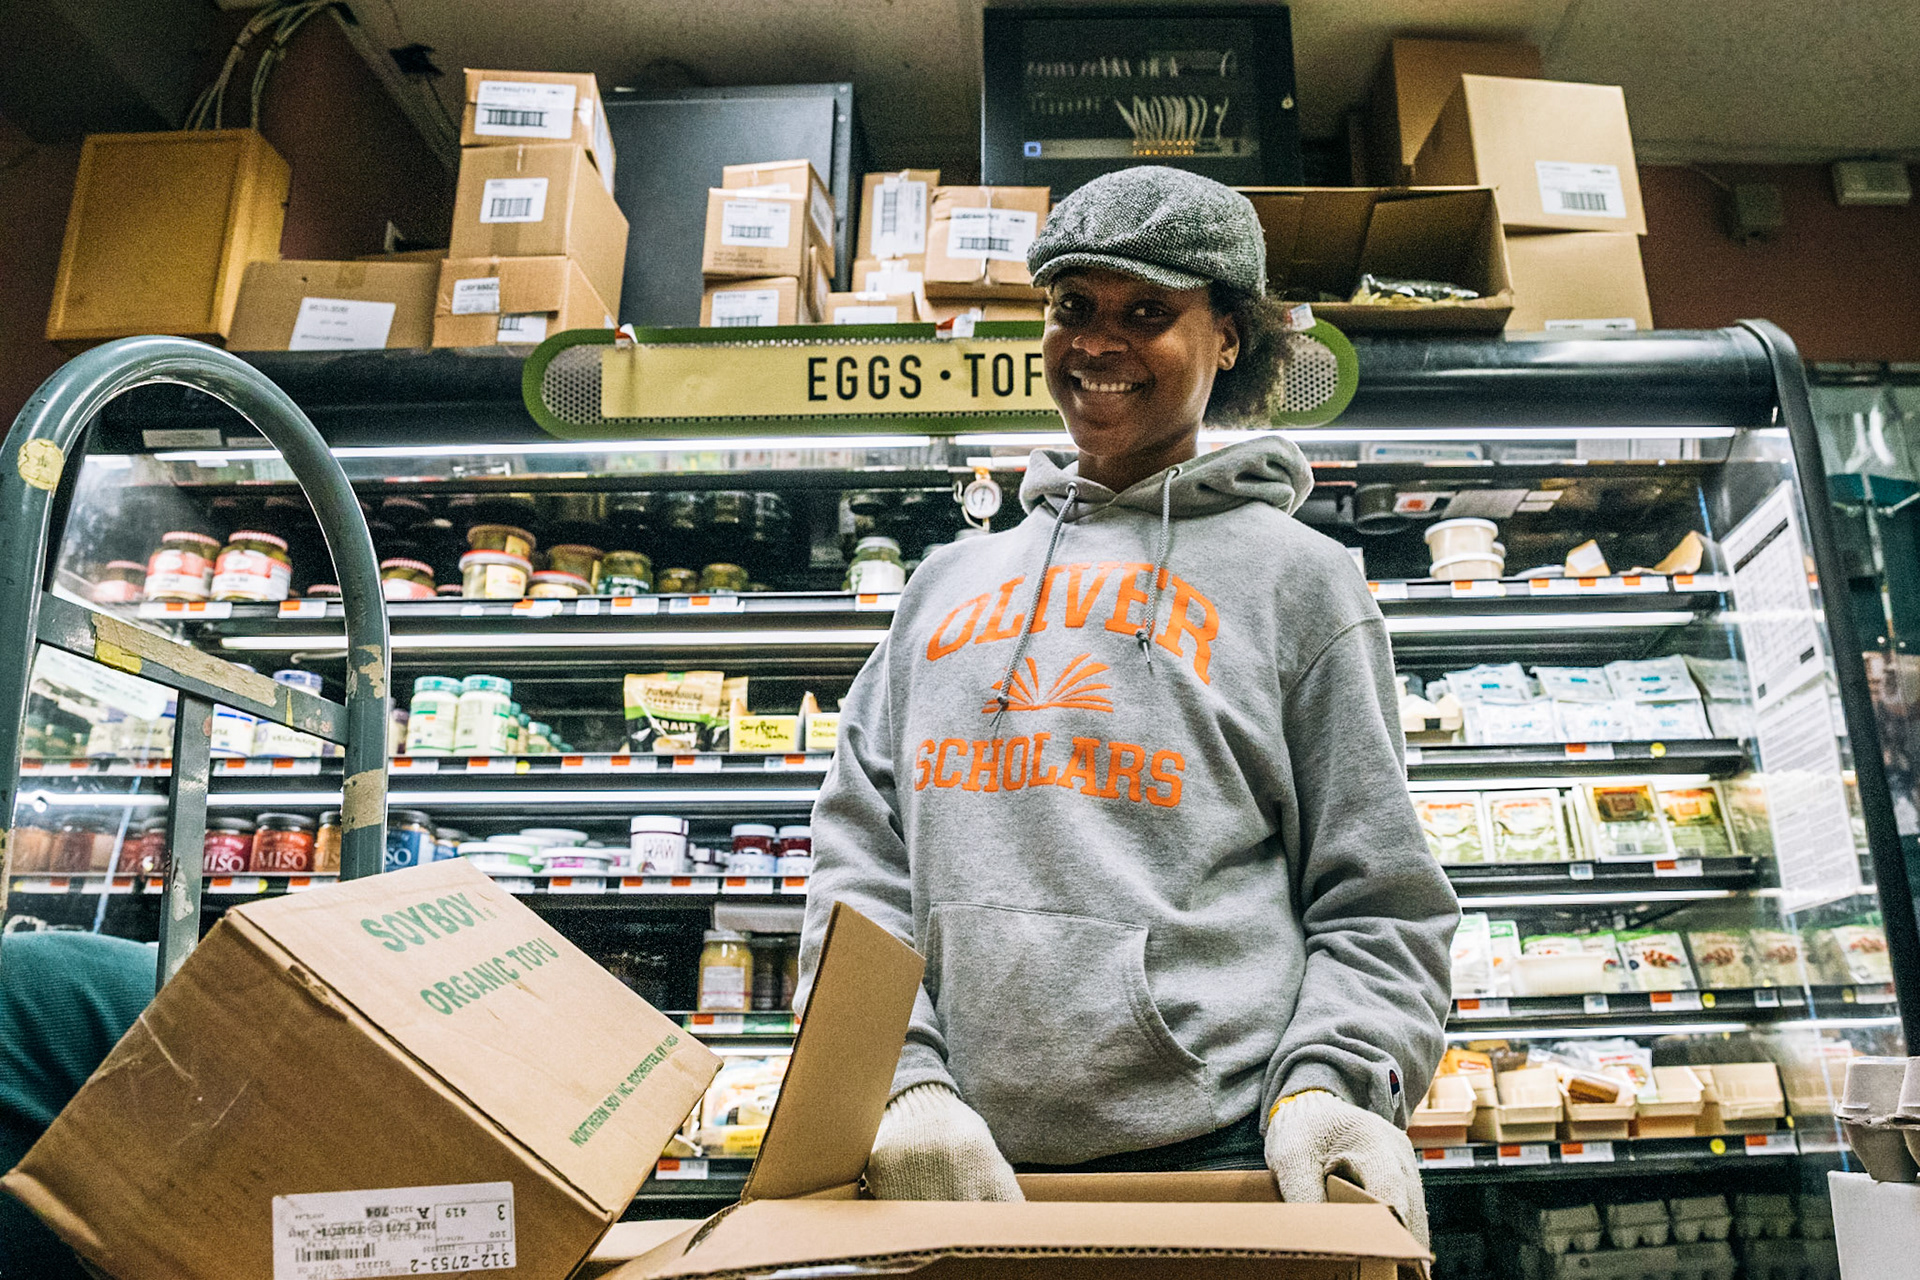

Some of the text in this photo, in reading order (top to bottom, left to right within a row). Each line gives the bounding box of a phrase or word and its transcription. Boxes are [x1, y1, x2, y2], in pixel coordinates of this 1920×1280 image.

[808, 352, 1043, 401] EGGS TOF
[926, 560, 1220, 685] OLIVER
[658, 718, 697, 732] RAUT
[914, 731, 1186, 808] SCHOLARS
[257, 850, 307, 872] MISO
[385, 847, 412, 866] SO
[360, 892, 484, 952] SOYBOY
[420, 937, 559, 1015] ORGANIC TOFU
[569, 1105, 612, 1148] NORTHERN
[603, 1090, 624, 1111] SOY
[366, 1206, 389, 1218] 704
[417, 1206, 430, 1219] A
[445, 1206, 467, 1218] 419
[497, 1203, 506, 1221] 3
[410, 1252, 510, 1272] 312-Z753-2
